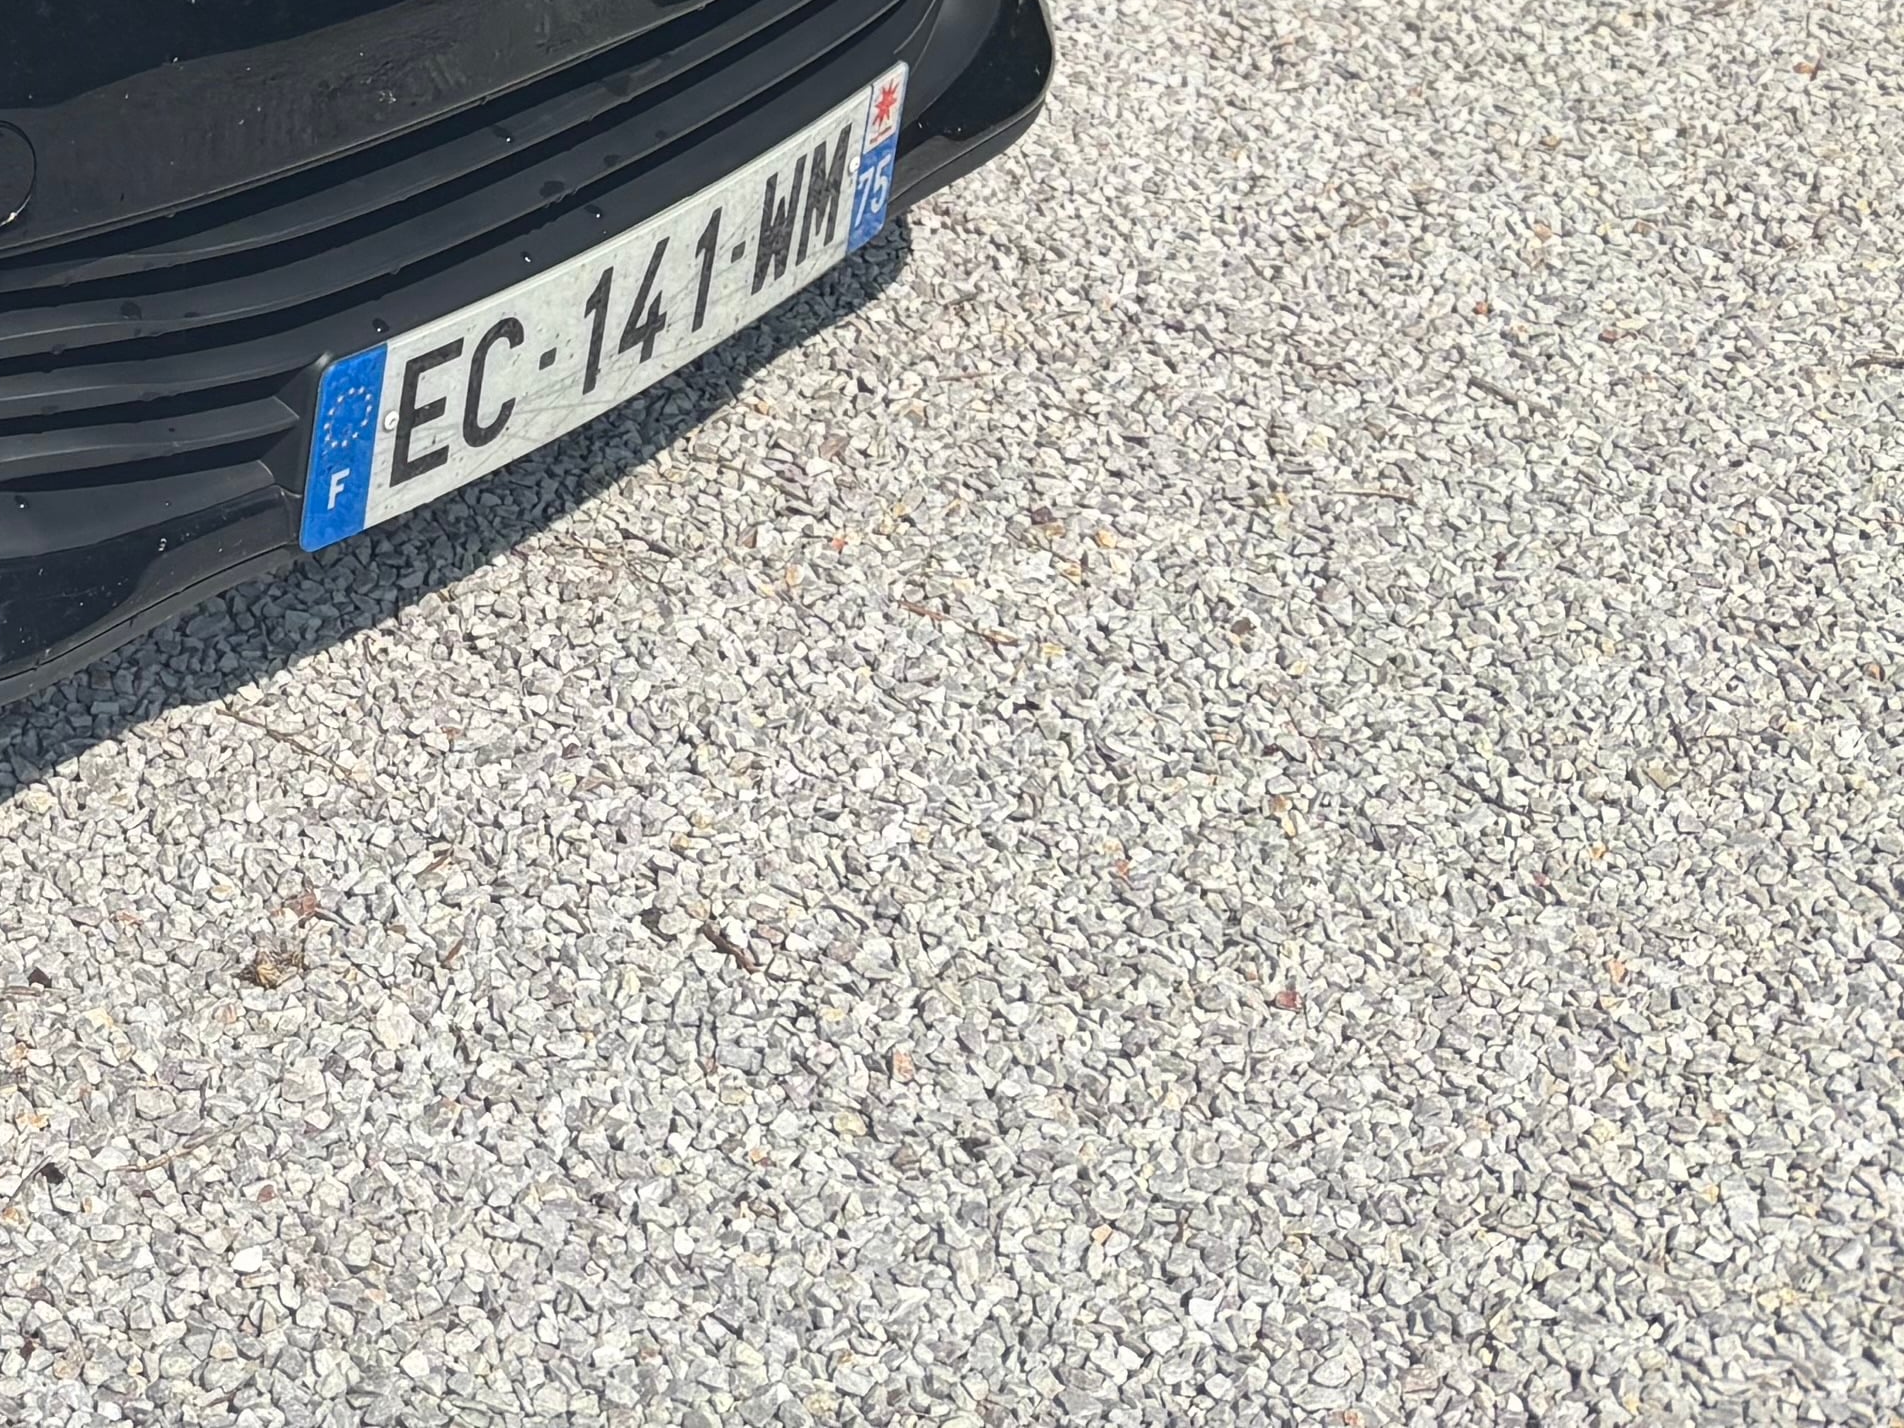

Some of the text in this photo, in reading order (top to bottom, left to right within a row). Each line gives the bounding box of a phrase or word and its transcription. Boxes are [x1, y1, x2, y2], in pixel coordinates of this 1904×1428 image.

[853, 153, 893, 231] 75
[388, 122, 853, 489] EC-141-WM
[326, 467, 350, 511] F
